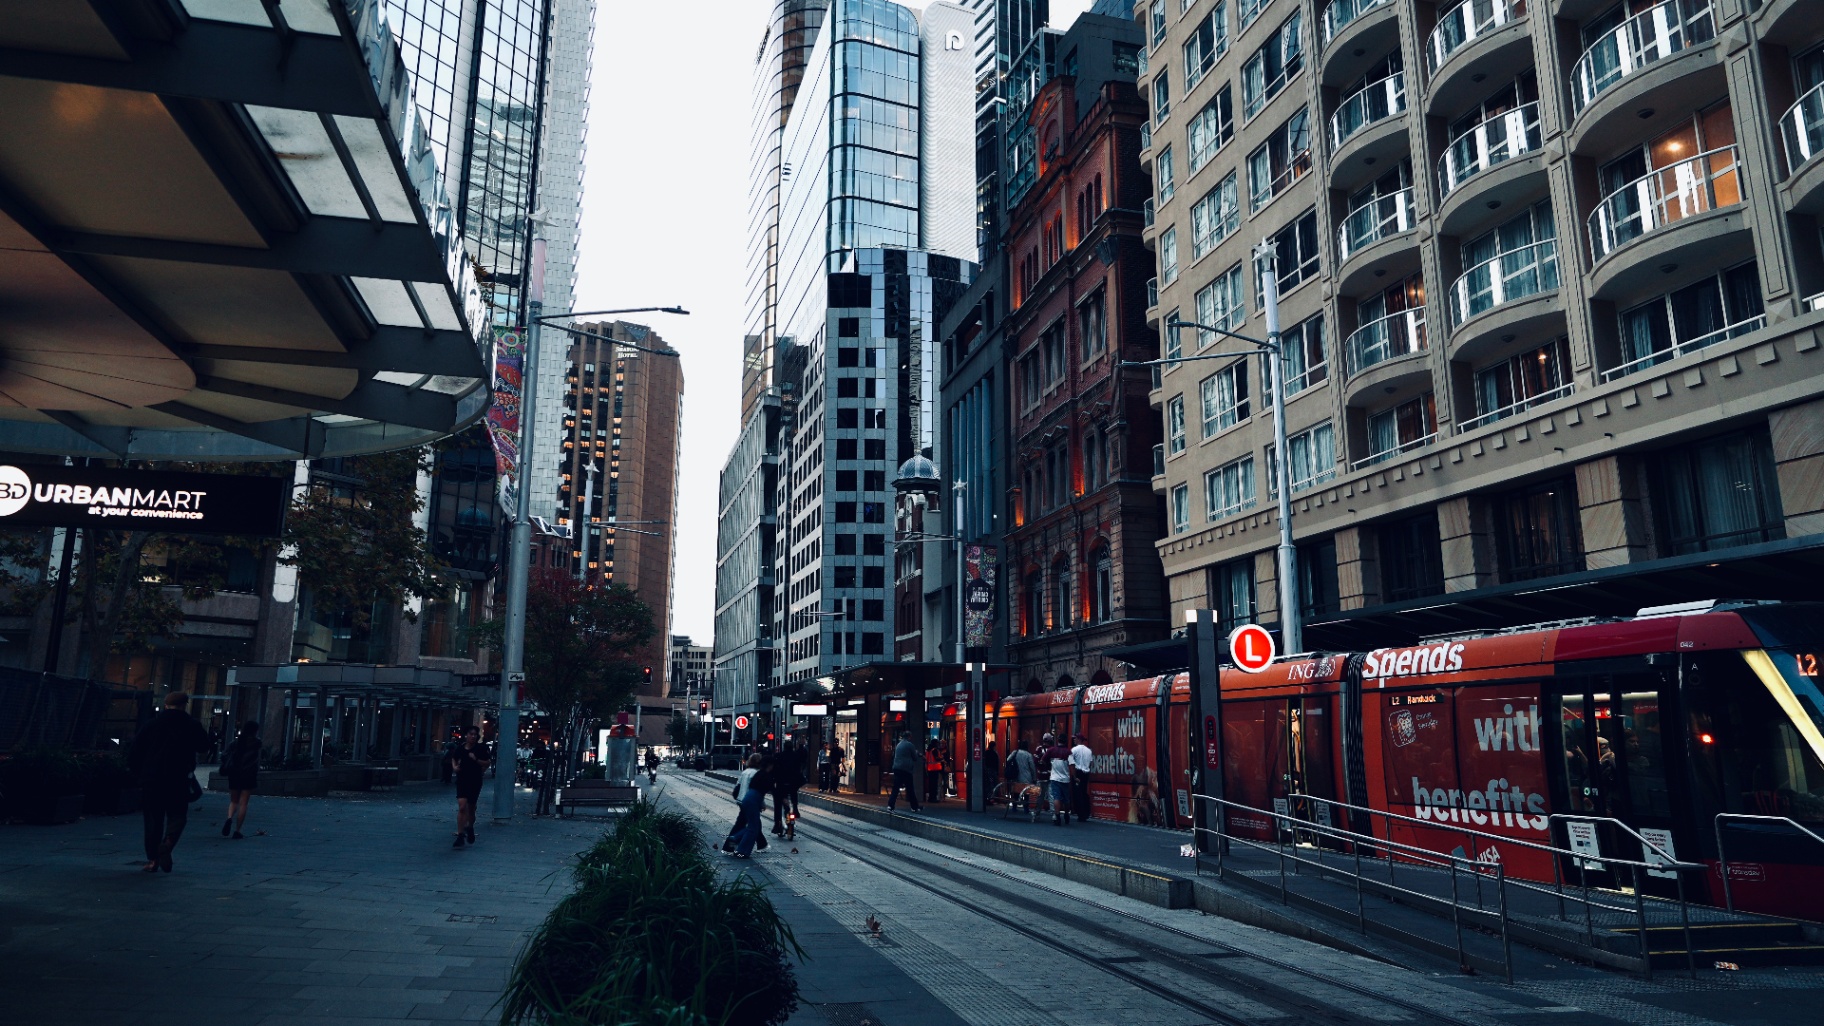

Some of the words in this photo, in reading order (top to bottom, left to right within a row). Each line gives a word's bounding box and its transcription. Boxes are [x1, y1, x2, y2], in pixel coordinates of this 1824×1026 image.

[88, 505, 101, 516] at
[102, 507, 130, 518] your
[130, 508, 204, 520] convenience
[1245, 634, 1263, 662] L
[1287, 662, 1316, 681] ING
[1362, 641, 1465, 689] Spends
[1795, 653, 1819, 677] L2
[1084, 683, 1126, 711] Spends
[1117, 709, 1145, 738] with
[1411, 776, 1550, 831] benefits
